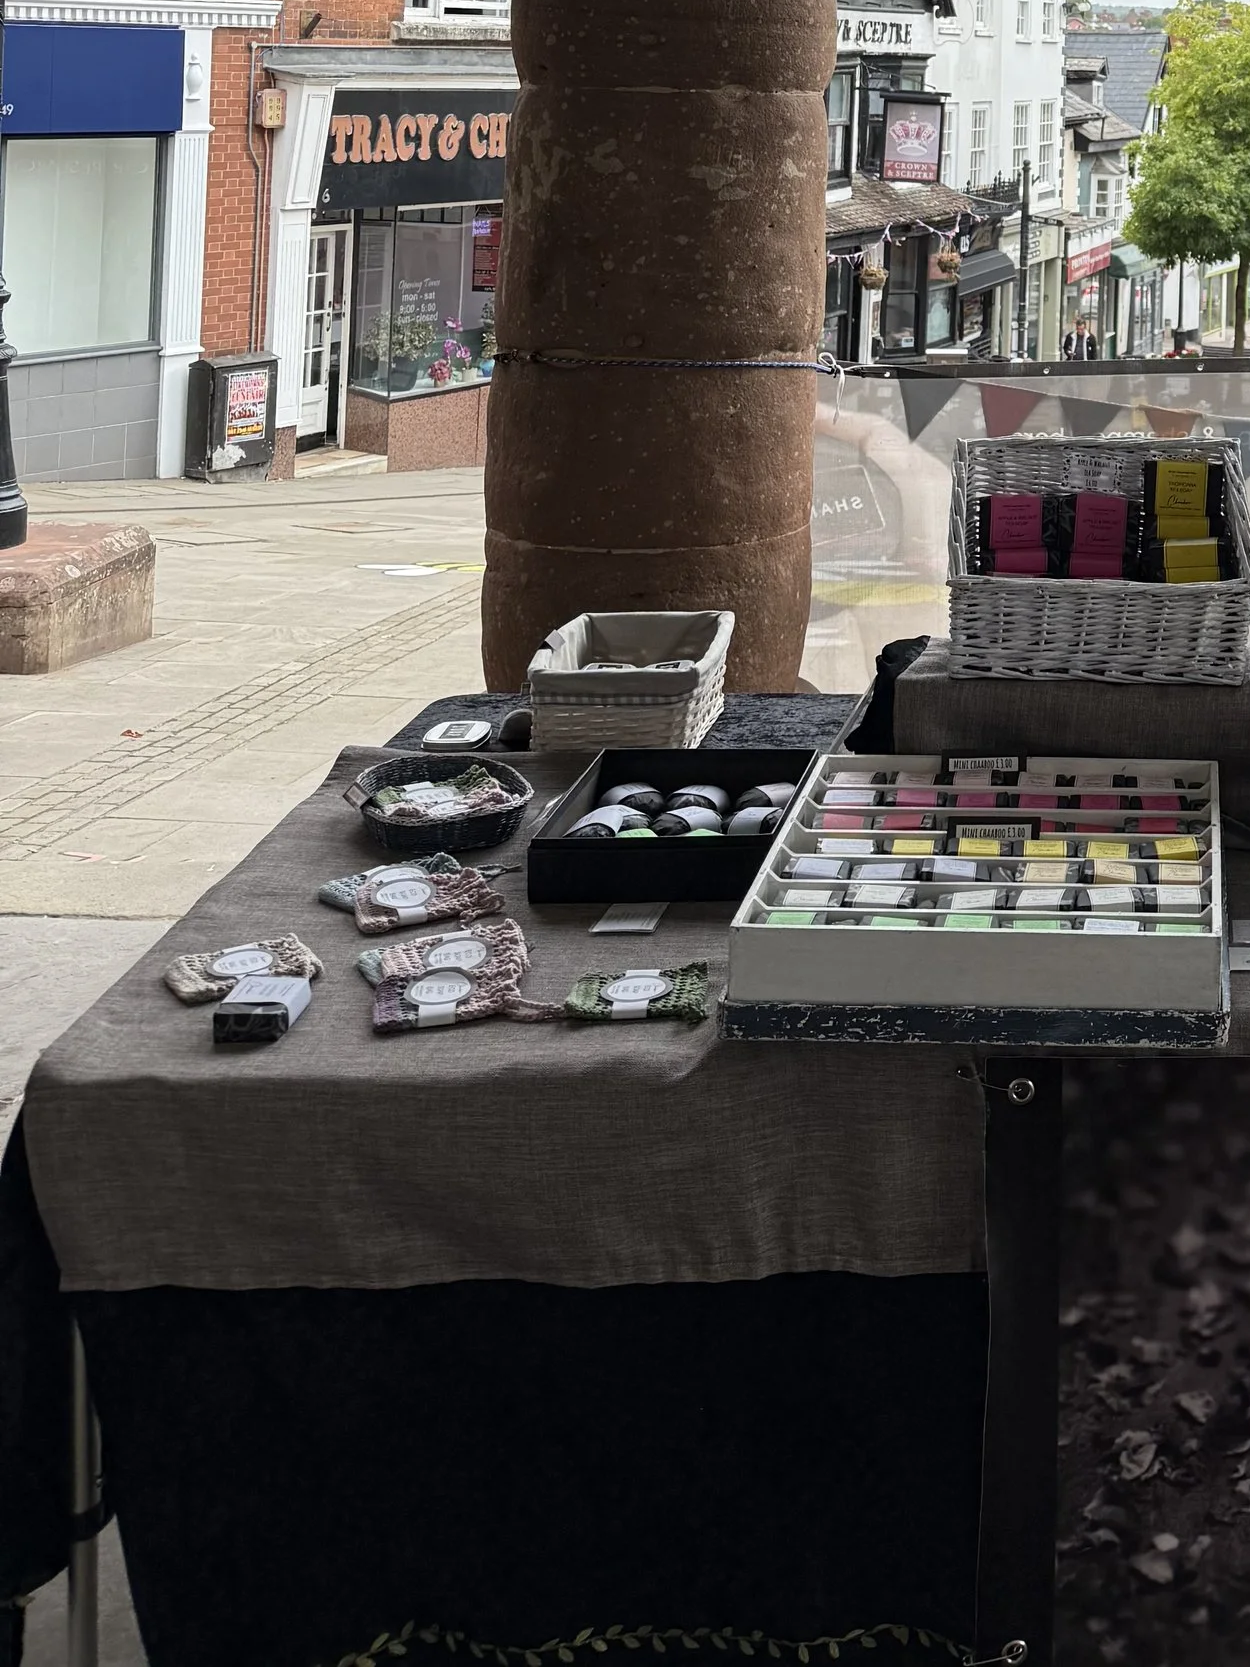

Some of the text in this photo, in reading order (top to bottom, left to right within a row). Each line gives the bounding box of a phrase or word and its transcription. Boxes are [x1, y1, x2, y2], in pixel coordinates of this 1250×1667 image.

[856, 20, 912, 44] SCEPTRE
[331, 112, 512, 164] TRACY & CH
[895, 162, 927, 171] CROWN
[887, 169, 934, 178] & SCEPTRE
[322, 189, 330, 203] 6
[402, 293, 418, 302] mon
[424, 291, 436, 300] sat
[954, 757, 1013, 770] MINI CHAABOO £3.00
[962, 827, 1026, 838] MINI CHAABOO £3.00
